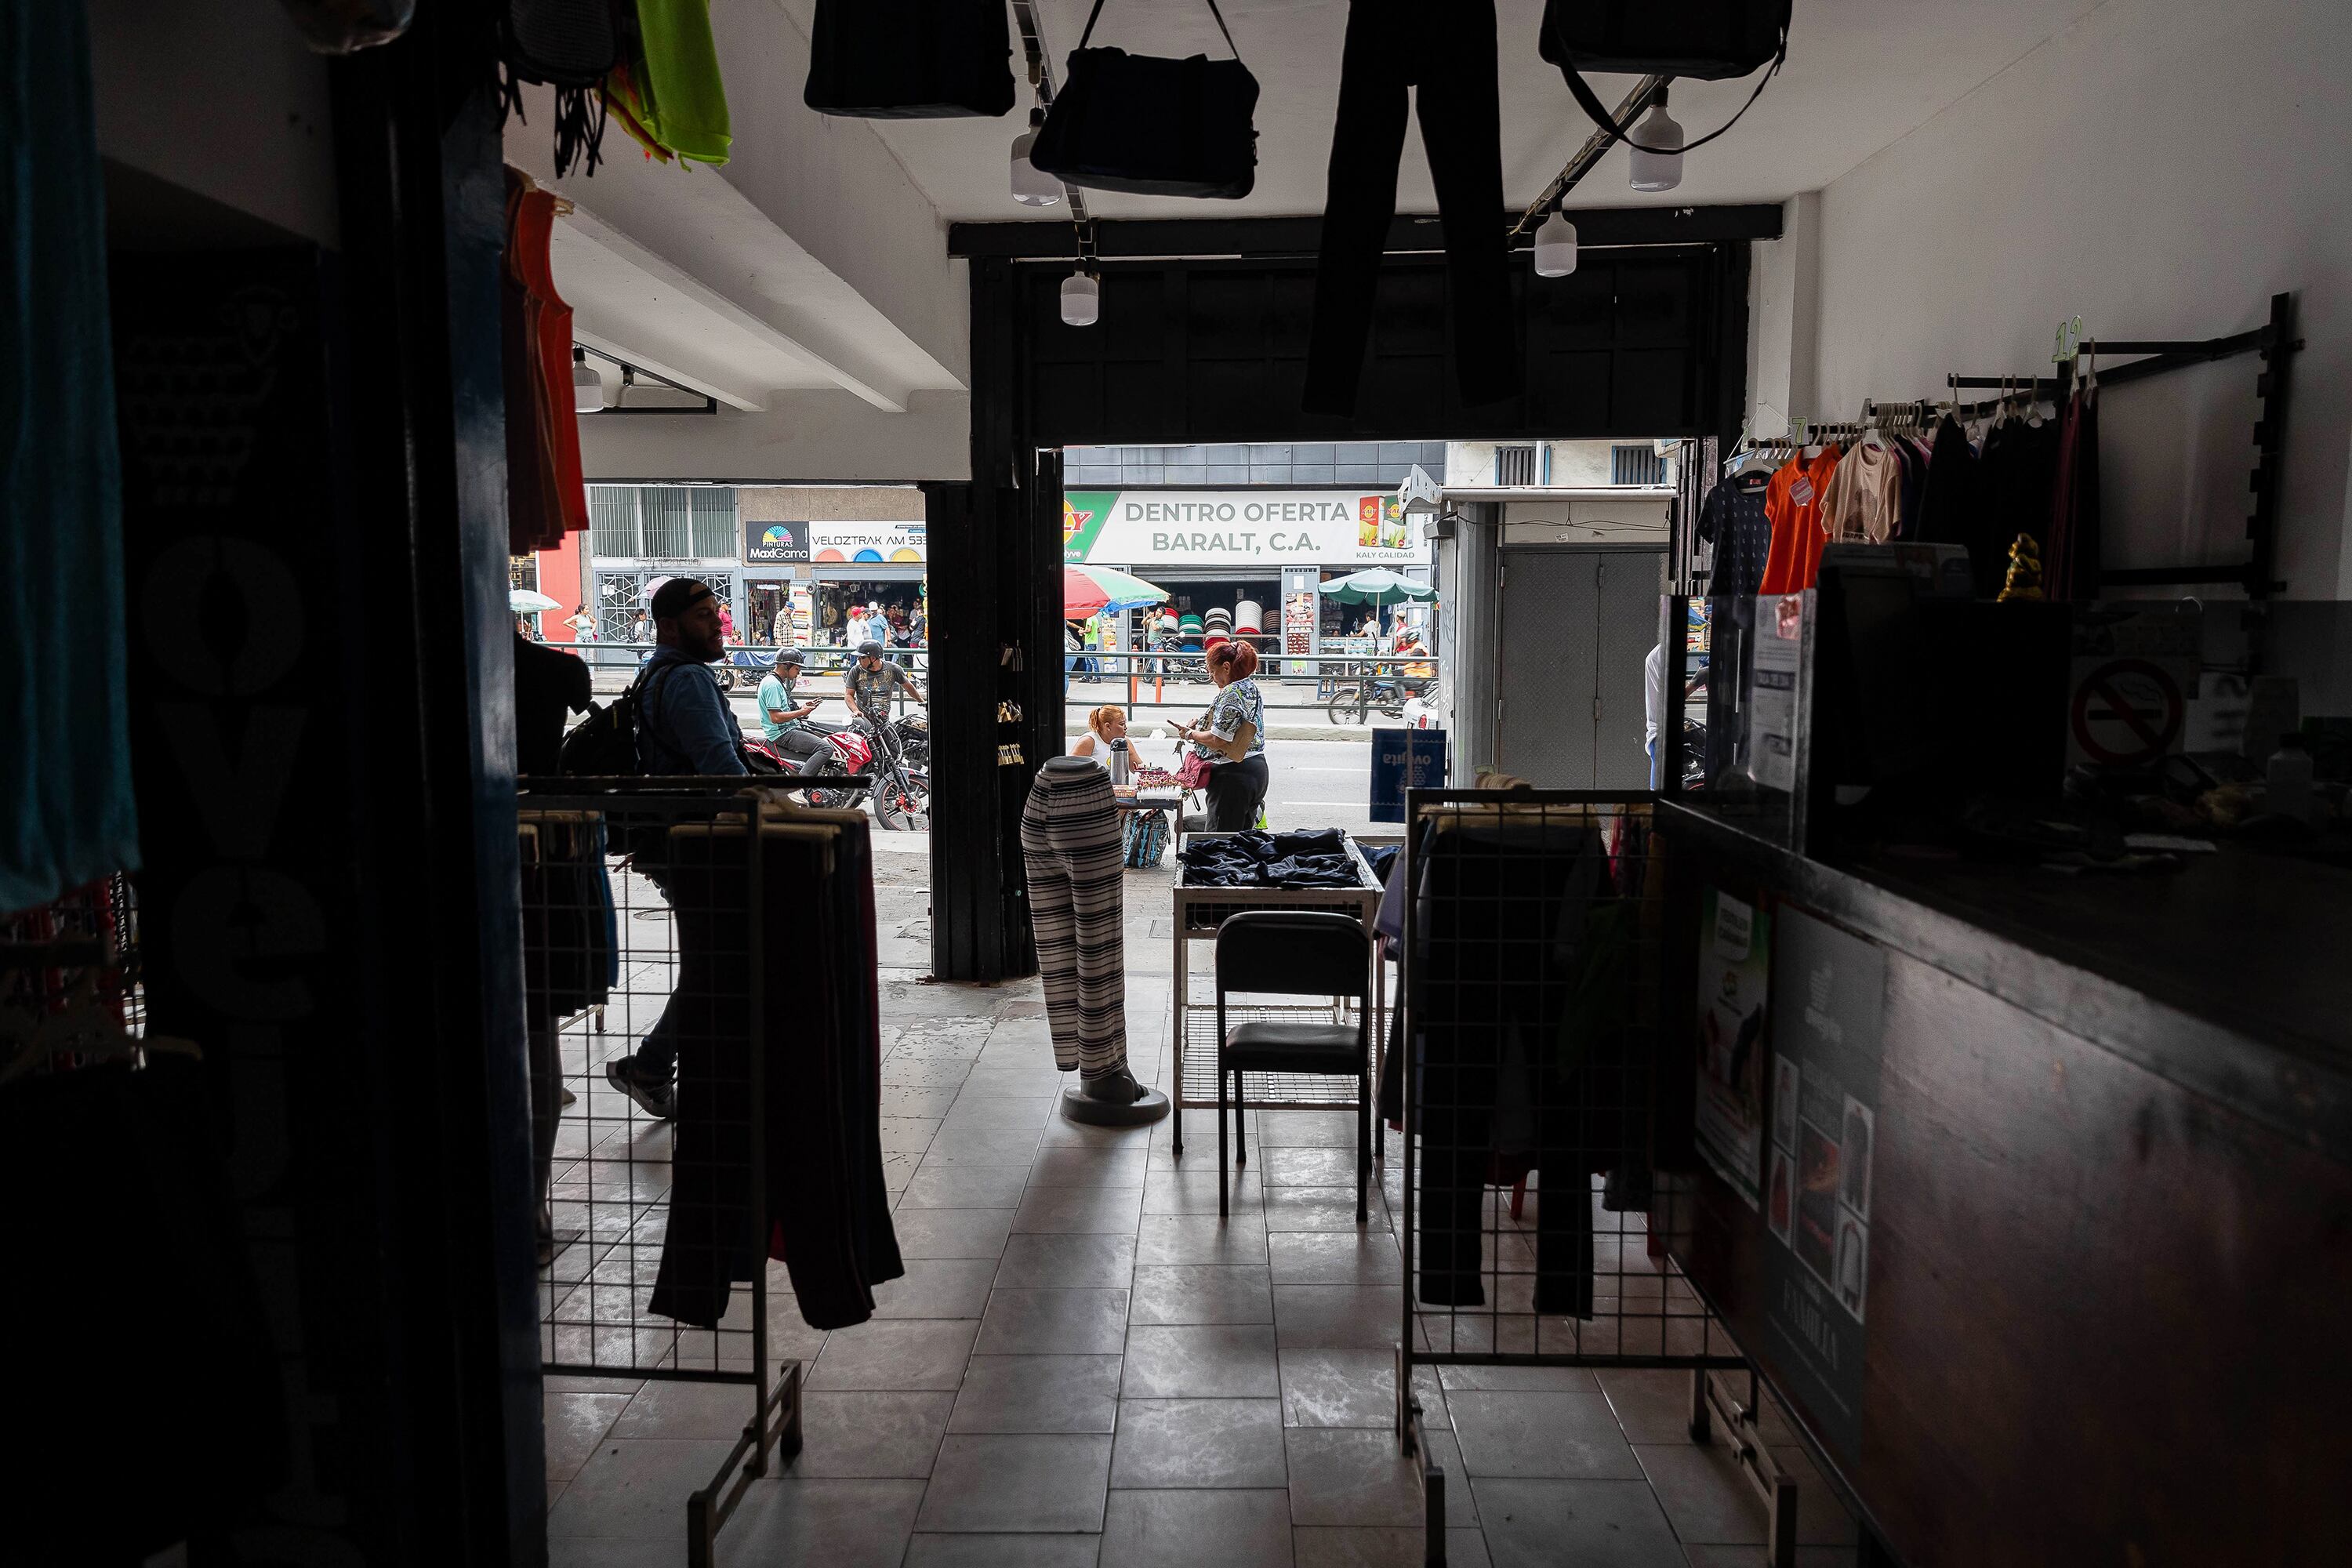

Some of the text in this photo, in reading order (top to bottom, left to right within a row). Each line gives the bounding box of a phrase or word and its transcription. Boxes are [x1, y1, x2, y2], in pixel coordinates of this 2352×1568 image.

[2052, 316, 2082, 363] 12
[1791, 417, 1806, 445] 7
[1125, 502, 1350, 522] DENTRO OFERTA
[811, 535, 882, 546] VELOZTRAK
[886, 535, 905, 546] AM
[1152, 532, 1322, 555] BARALT, C.A.
[750, 546, 808, 560] MaxiGama
[1381, 750, 1432, 768] ovjita
